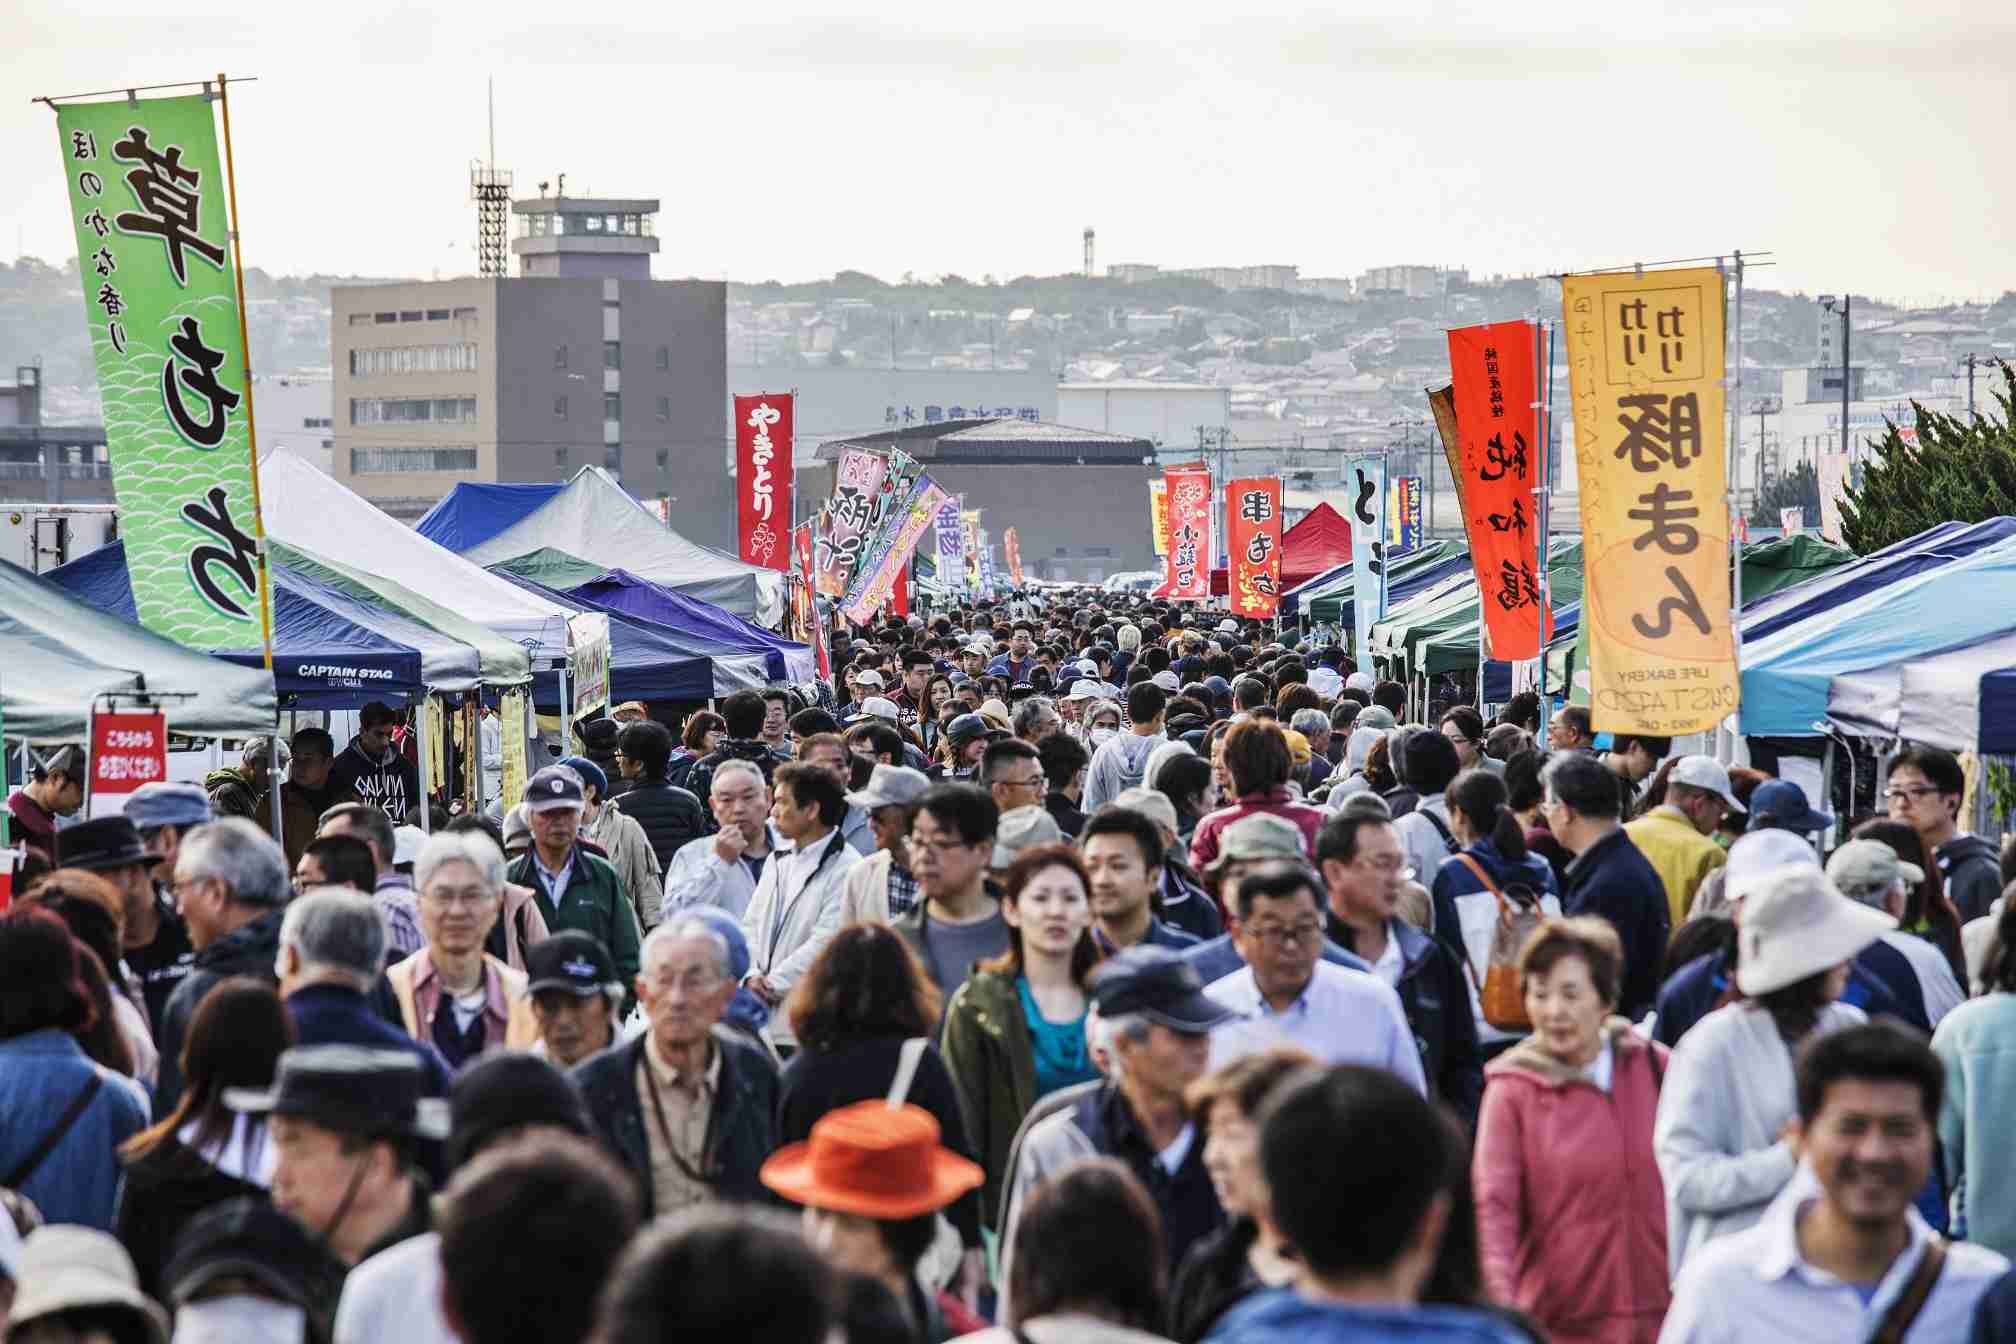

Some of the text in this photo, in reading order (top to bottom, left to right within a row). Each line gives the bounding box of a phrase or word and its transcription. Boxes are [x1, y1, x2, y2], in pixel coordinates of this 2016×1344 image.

[747, 402, 781, 521] やきとり
[298, 664, 393, 679] CAPTAIN STAG
[354, 774, 405, 797] CALVIN
